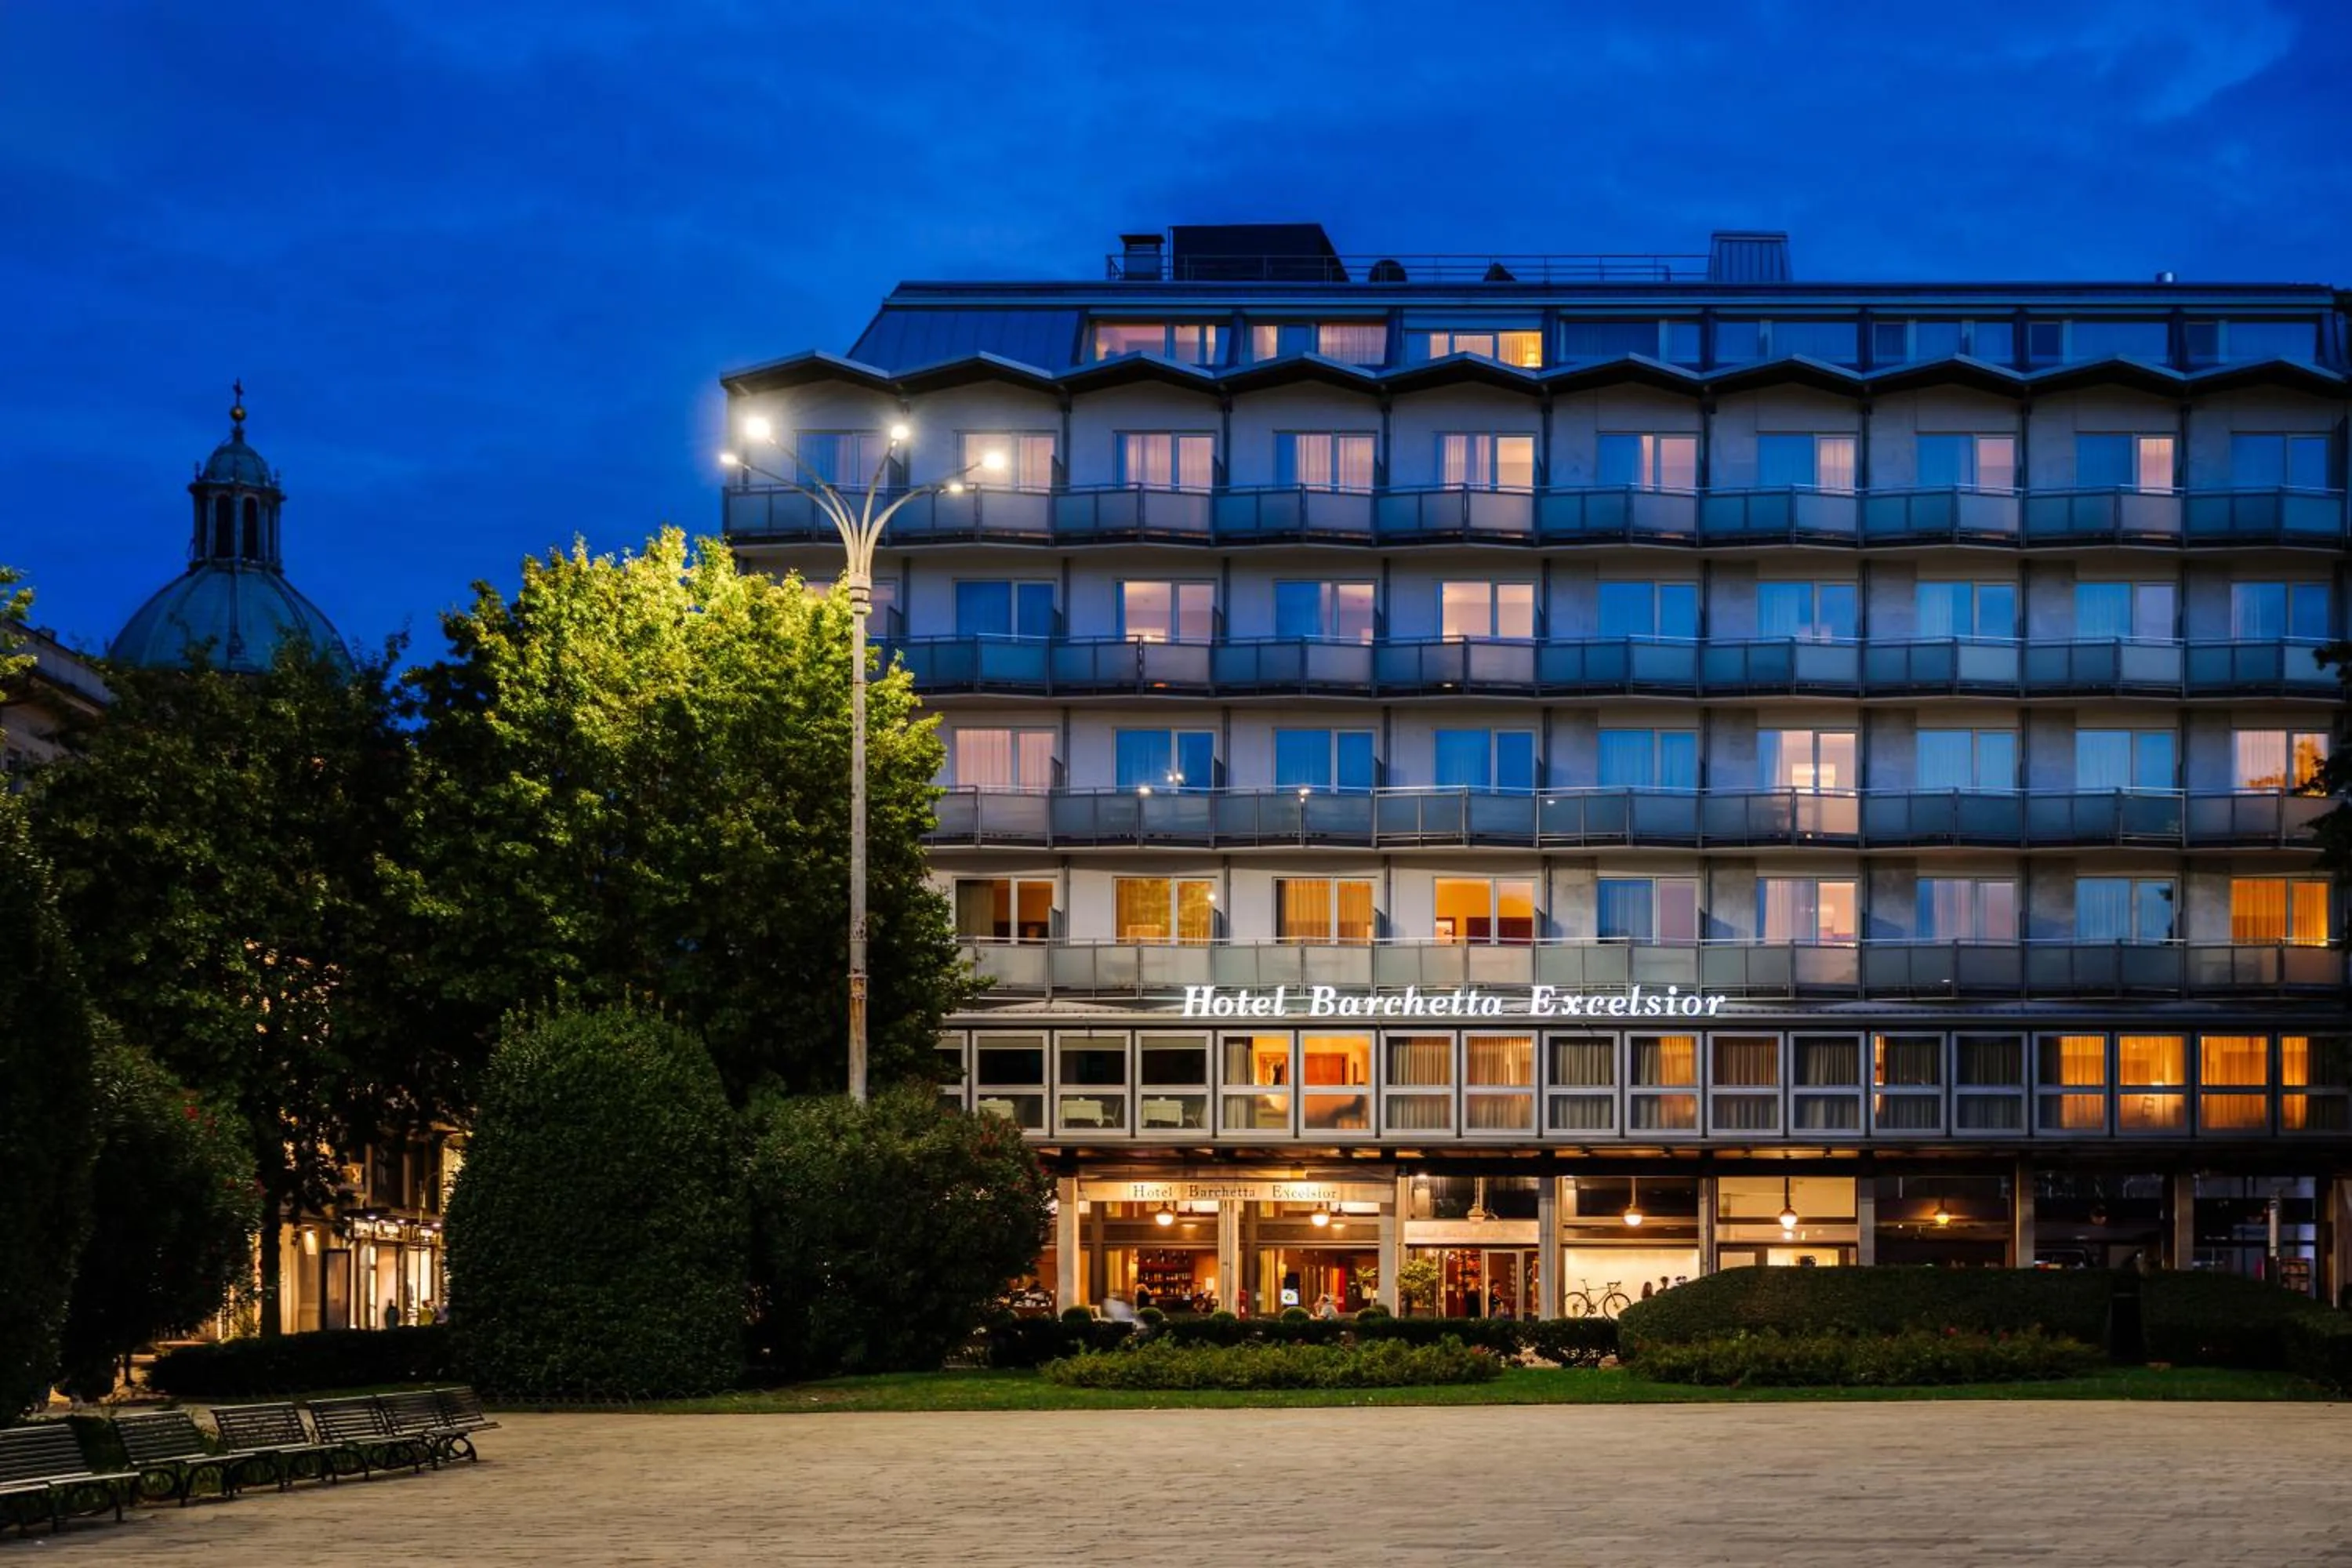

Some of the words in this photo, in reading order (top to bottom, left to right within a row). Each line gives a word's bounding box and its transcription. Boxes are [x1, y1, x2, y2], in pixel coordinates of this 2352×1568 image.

[1182, 985, 1286, 1017] Hotel
[1308, 985, 1503, 1017] Barchetta
[1530, 985, 1726, 1016] Excelsior
[1133, 1185, 1173, 1199] Hotel
[1189, 1185, 1255, 1198] Barchetta
[1272, 1185, 1337, 1200] Excelsior
